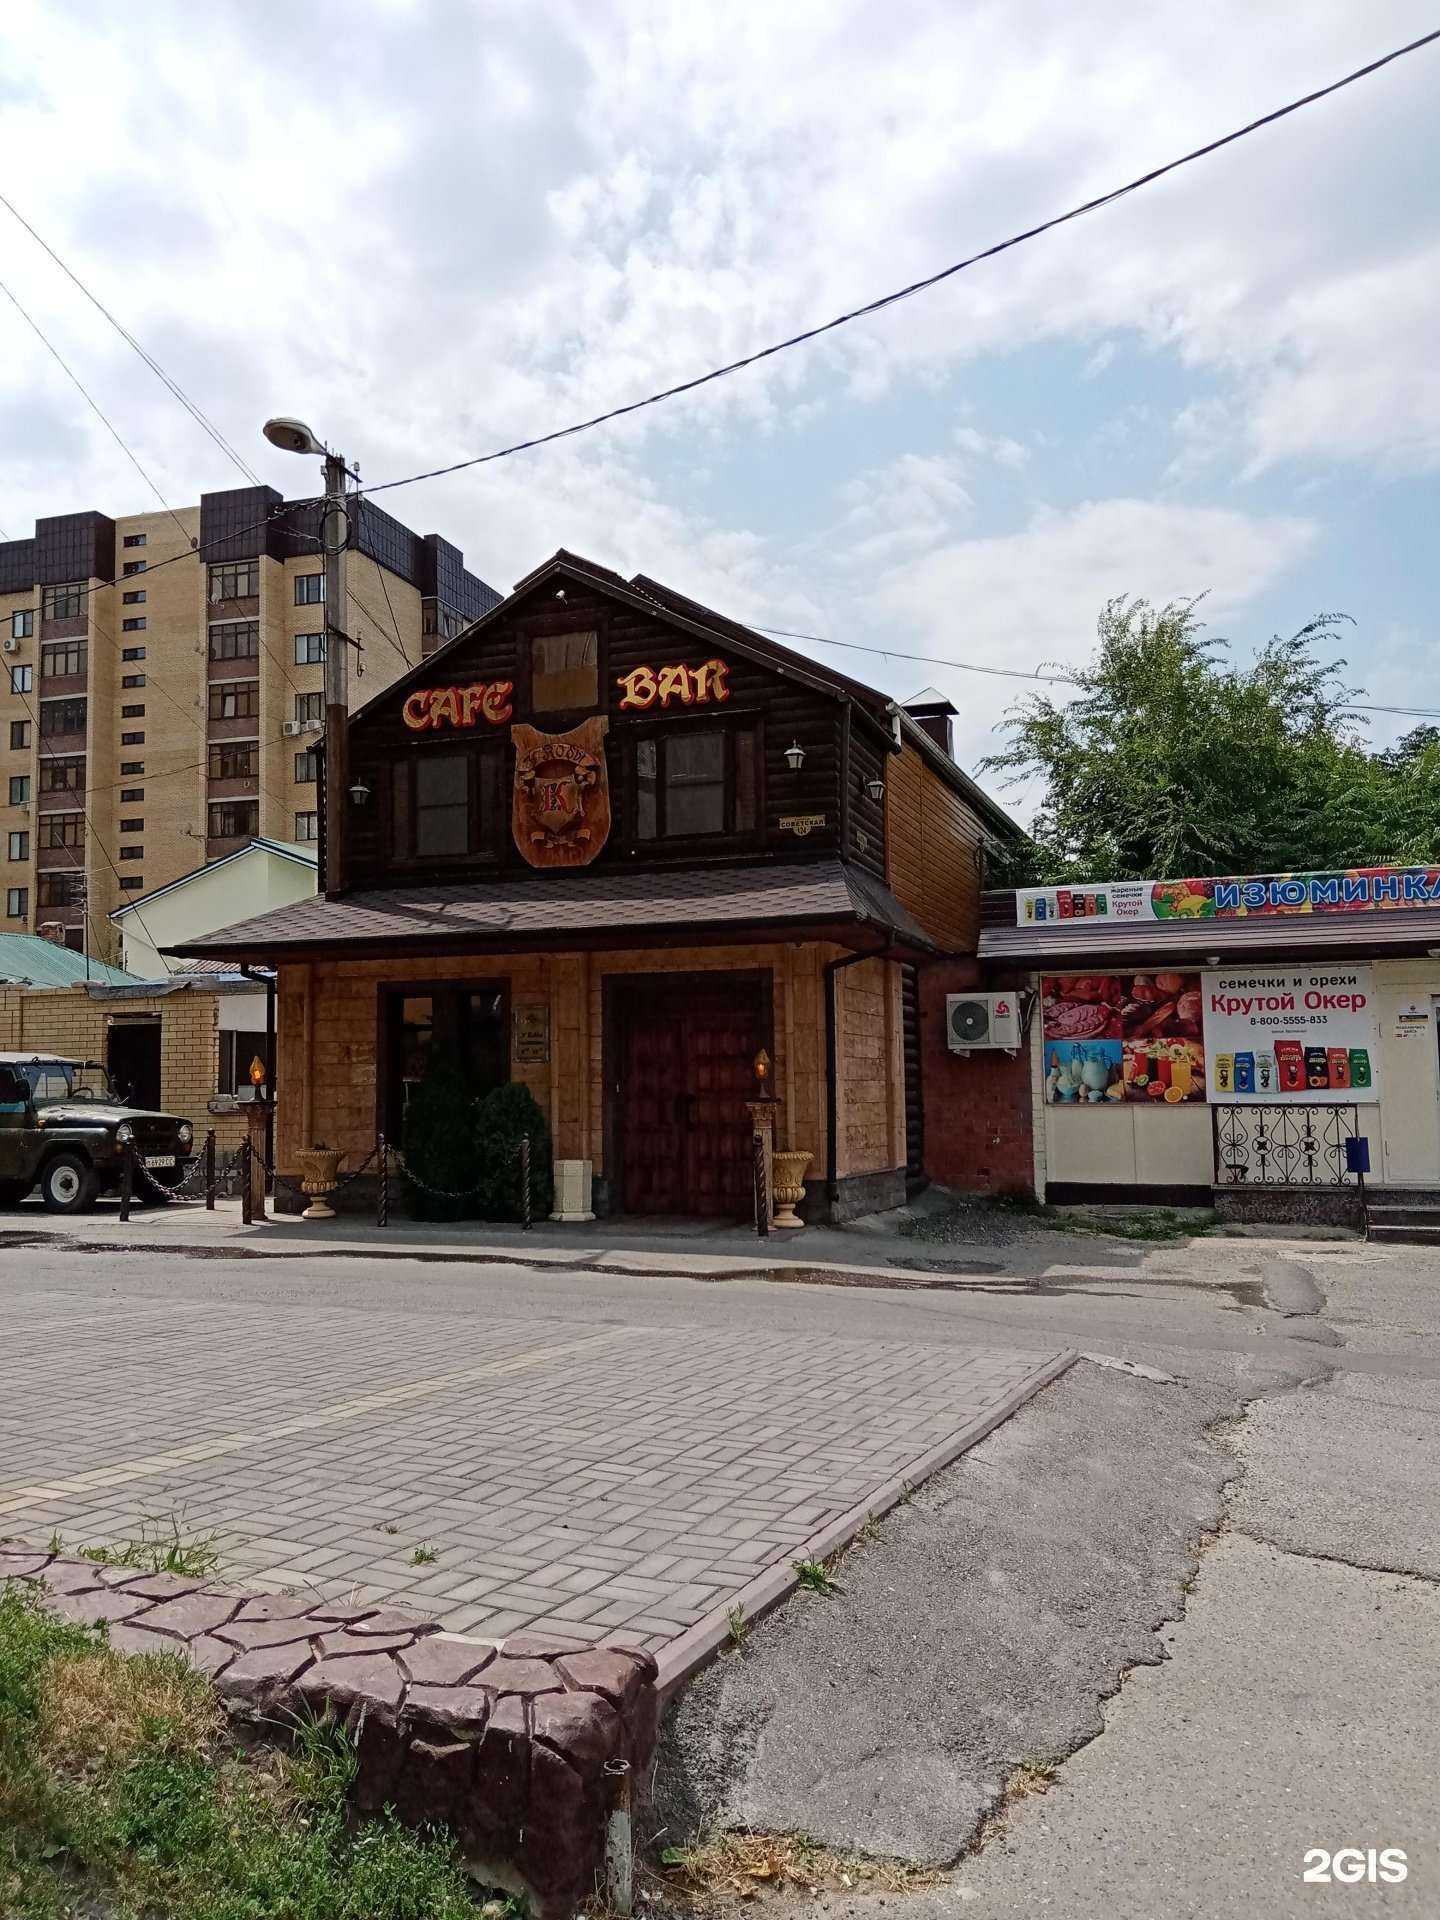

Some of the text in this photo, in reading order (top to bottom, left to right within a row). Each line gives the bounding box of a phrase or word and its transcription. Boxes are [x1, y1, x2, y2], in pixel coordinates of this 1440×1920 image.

[617, 659, 730, 710] BAR
[402, 681, 513, 731] CAFE
[1112, 899, 1143, 909] Крутой
[1116, 909, 1139, 917] Окер
[1219, 975, 1357, 990] семечки и орехи
[1211, 991, 1367, 1016] Крутой Окер
[1250, 1015, 1328, 1026] 8-800-5555-833
